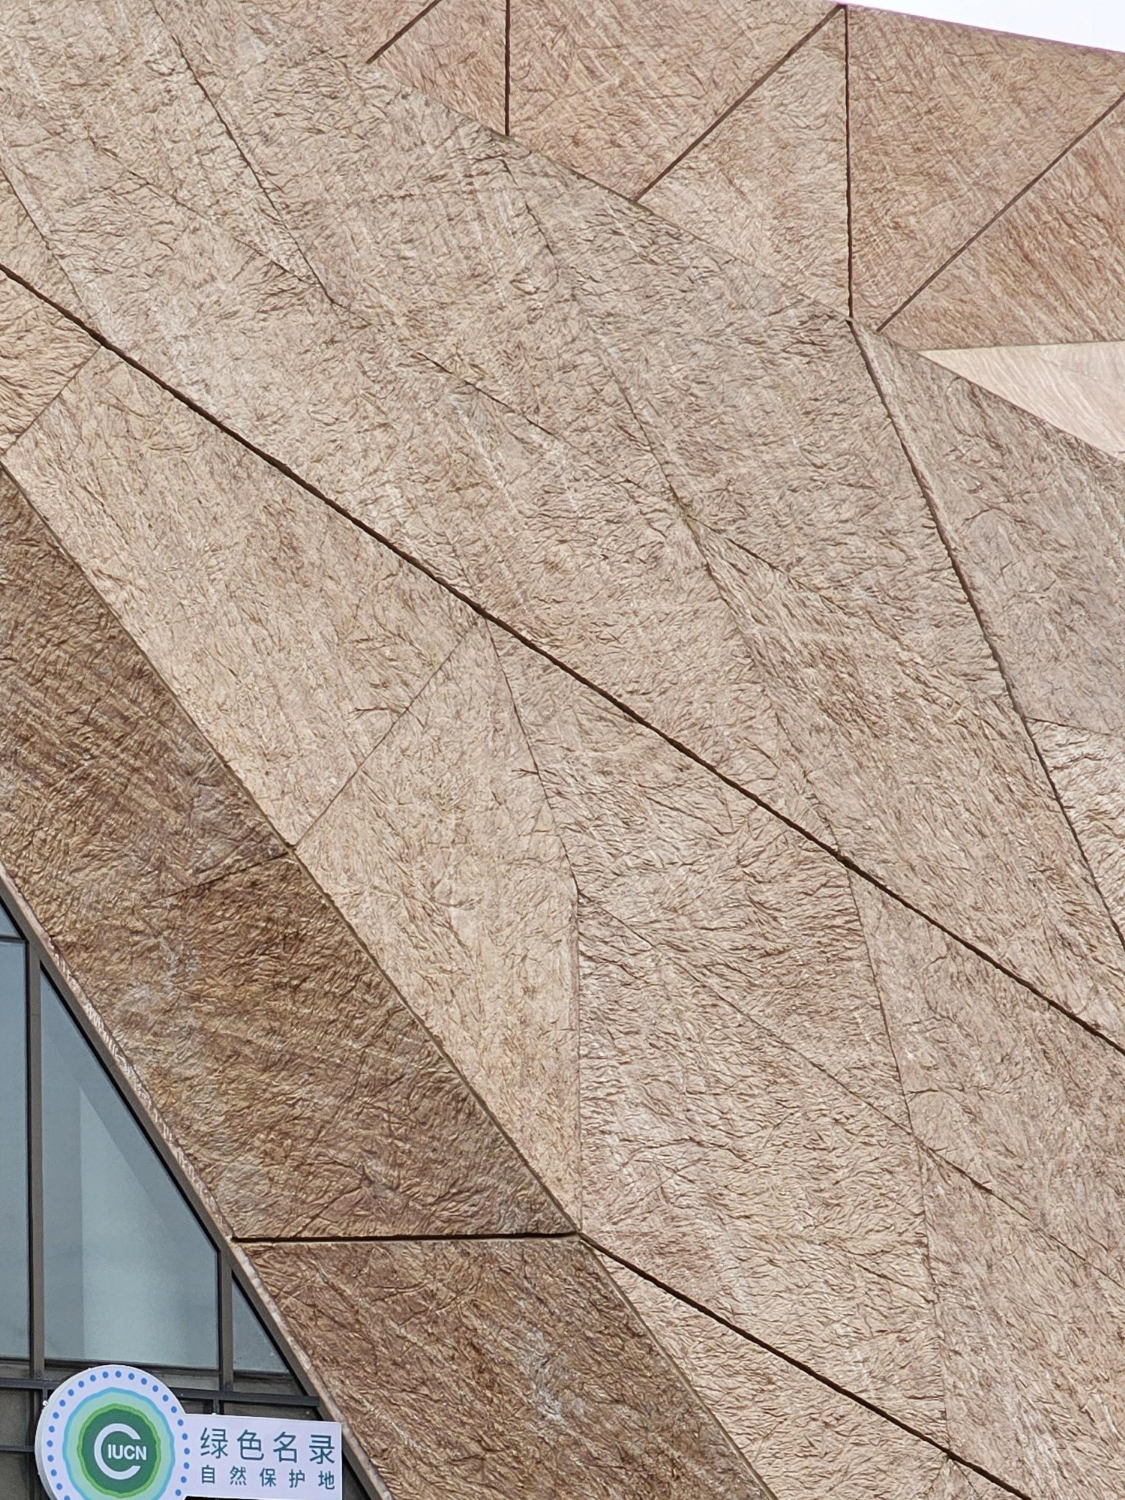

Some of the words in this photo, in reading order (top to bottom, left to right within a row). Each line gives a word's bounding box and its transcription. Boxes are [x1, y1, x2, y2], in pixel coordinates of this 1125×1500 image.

[107, 1443, 147, 1461] IUCN
[200, 1427, 336, 1465] 绿色名录
[200, 1464, 336, 1490] 自然保护地
